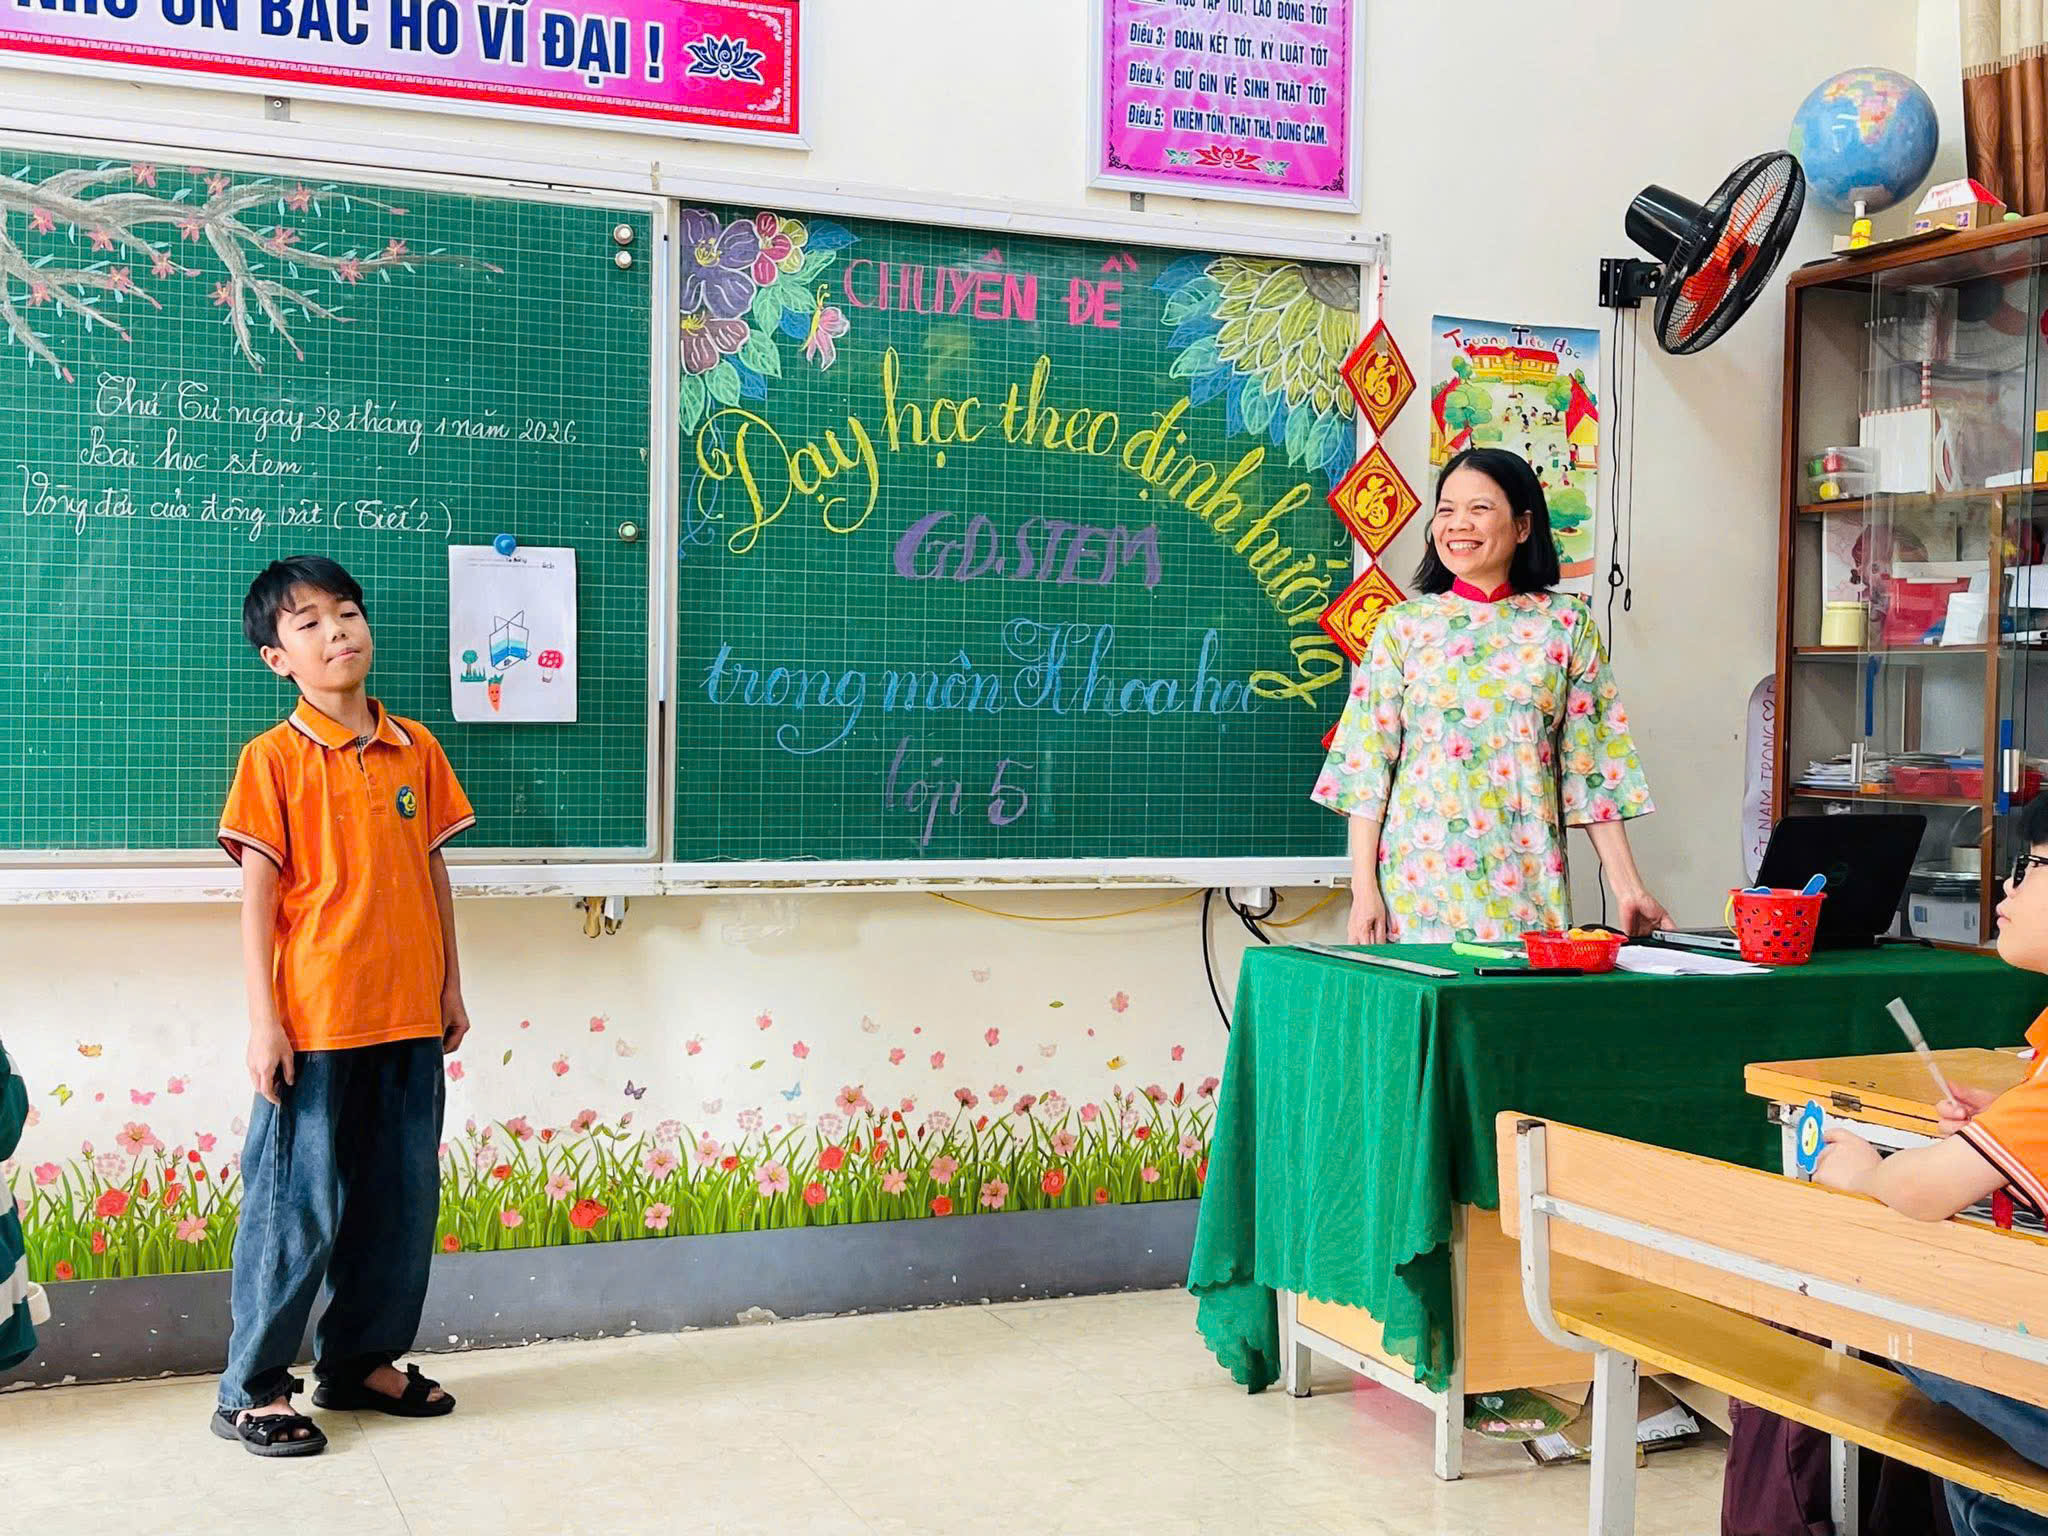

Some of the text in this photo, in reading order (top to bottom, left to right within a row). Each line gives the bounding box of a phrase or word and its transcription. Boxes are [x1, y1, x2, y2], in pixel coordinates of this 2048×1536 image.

[543, 12, 626, 84] ĐẠI
[649, 26, 660, 78] !
[1130, 21, 1152, 43] Điều
[1156, 27, 1166, 45] 3:
[1175, 27, 1203, 51] ĐOÀN
[1210, 29, 1228, 54] KẾT
[1235, 32, 1255, 59] TỐT,
[1280, 42, 1304, 67] LUẬT
[1311, 42, 1328, 66] TỐT
[1277, 0, 1304, 24] ĐỘNG
[1311, 2, 1327, 25] TỐT
[1129, 61, 1326, 106] Điều 4: GIỮ GÌN VỆ SINH THẬT TỐT
[1129, 102, 1327, 144] Điều 5: KHIÊM TỐN, THẬT THÀ, DŨNG CẢM.
[843, 247, 1138, 329] CHUYÊN ĐỀ
[80, 426, 139, 466] Bài
[96, 371, 168, 416] Thứ
[178, 380, 222, 421] Tư
[310, 405, 341, 433] 28
[347, 399, 423, 455] tháng
[435, 417, 446, 436] 1
[452, 409, 510, 439] năm
[519, 418, 577, 443] 2026
[697, 408, 879, 554] Dạy
[881, 346, 988, 469] học
[999, 355, 1120, 456] theo
[1122, 396, 1265, 533] định
[17, 465, 88, 536] Vòng
[95, 487, 137, 517] đời
[150, 488, 190, 519] của
[200, 493, 267, 541] động
[281, 499, 324, 532] vật
[700, 642, 867, 755] trong
[883, 649, 1008, 714] môn
[1003, 618, 1187, 717] Khoa
[885, 735, 1034, 846] lớp 5
[1758, 790, 1774, 831] NAM
